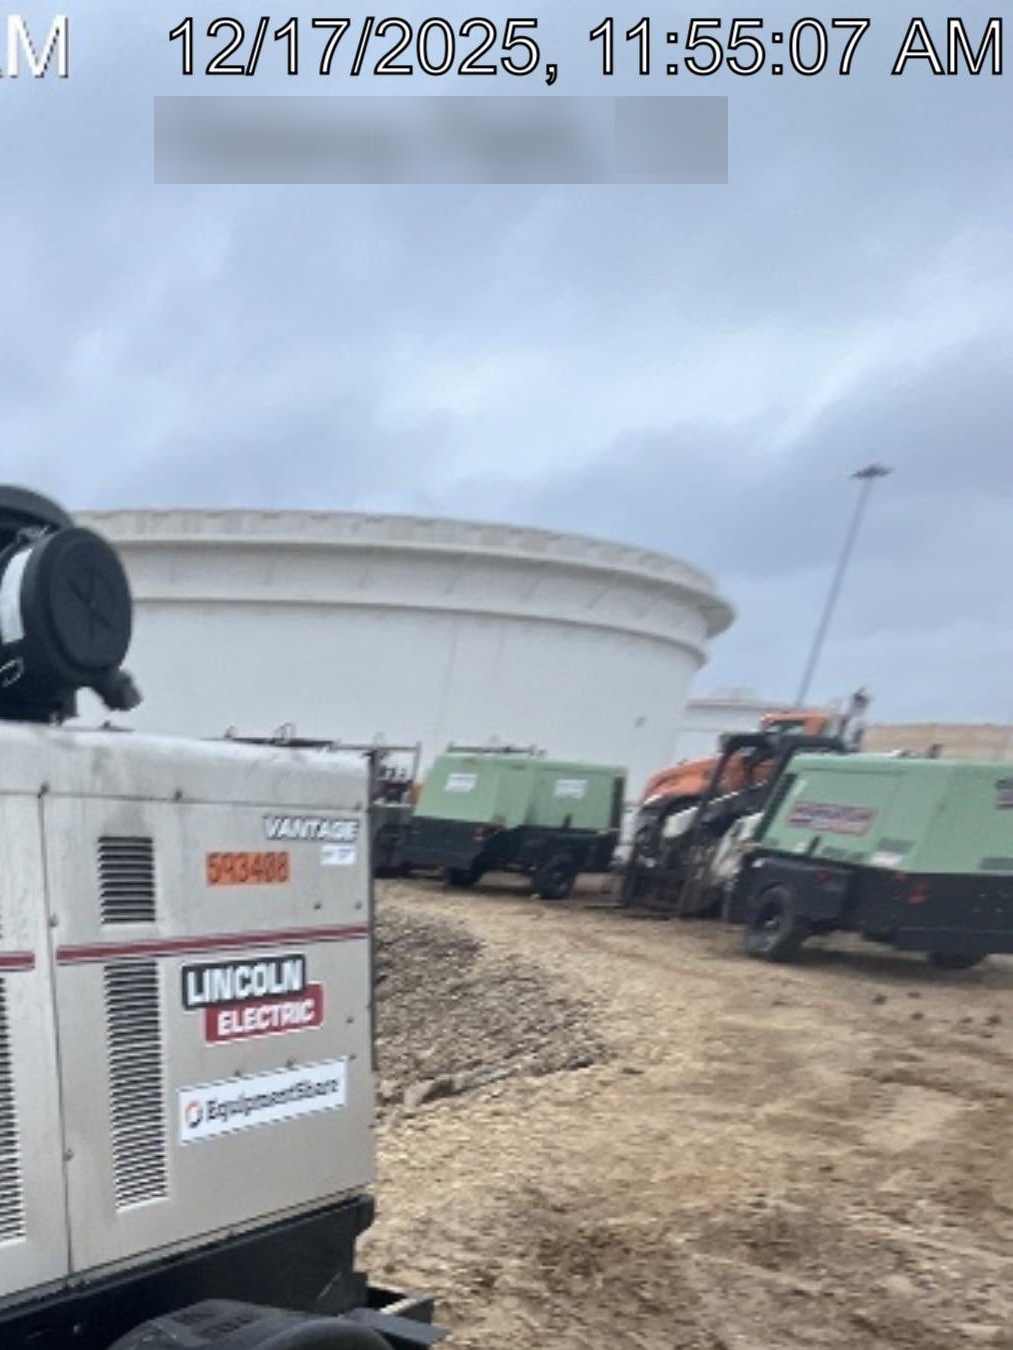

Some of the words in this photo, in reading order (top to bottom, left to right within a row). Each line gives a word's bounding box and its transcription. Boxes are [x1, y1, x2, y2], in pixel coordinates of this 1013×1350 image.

[264, 815, 359, 842] VANTAGE
[187, 959, 303, 1006] LINCOLN
[217, 998, 315, 1036] ELECTRIC
